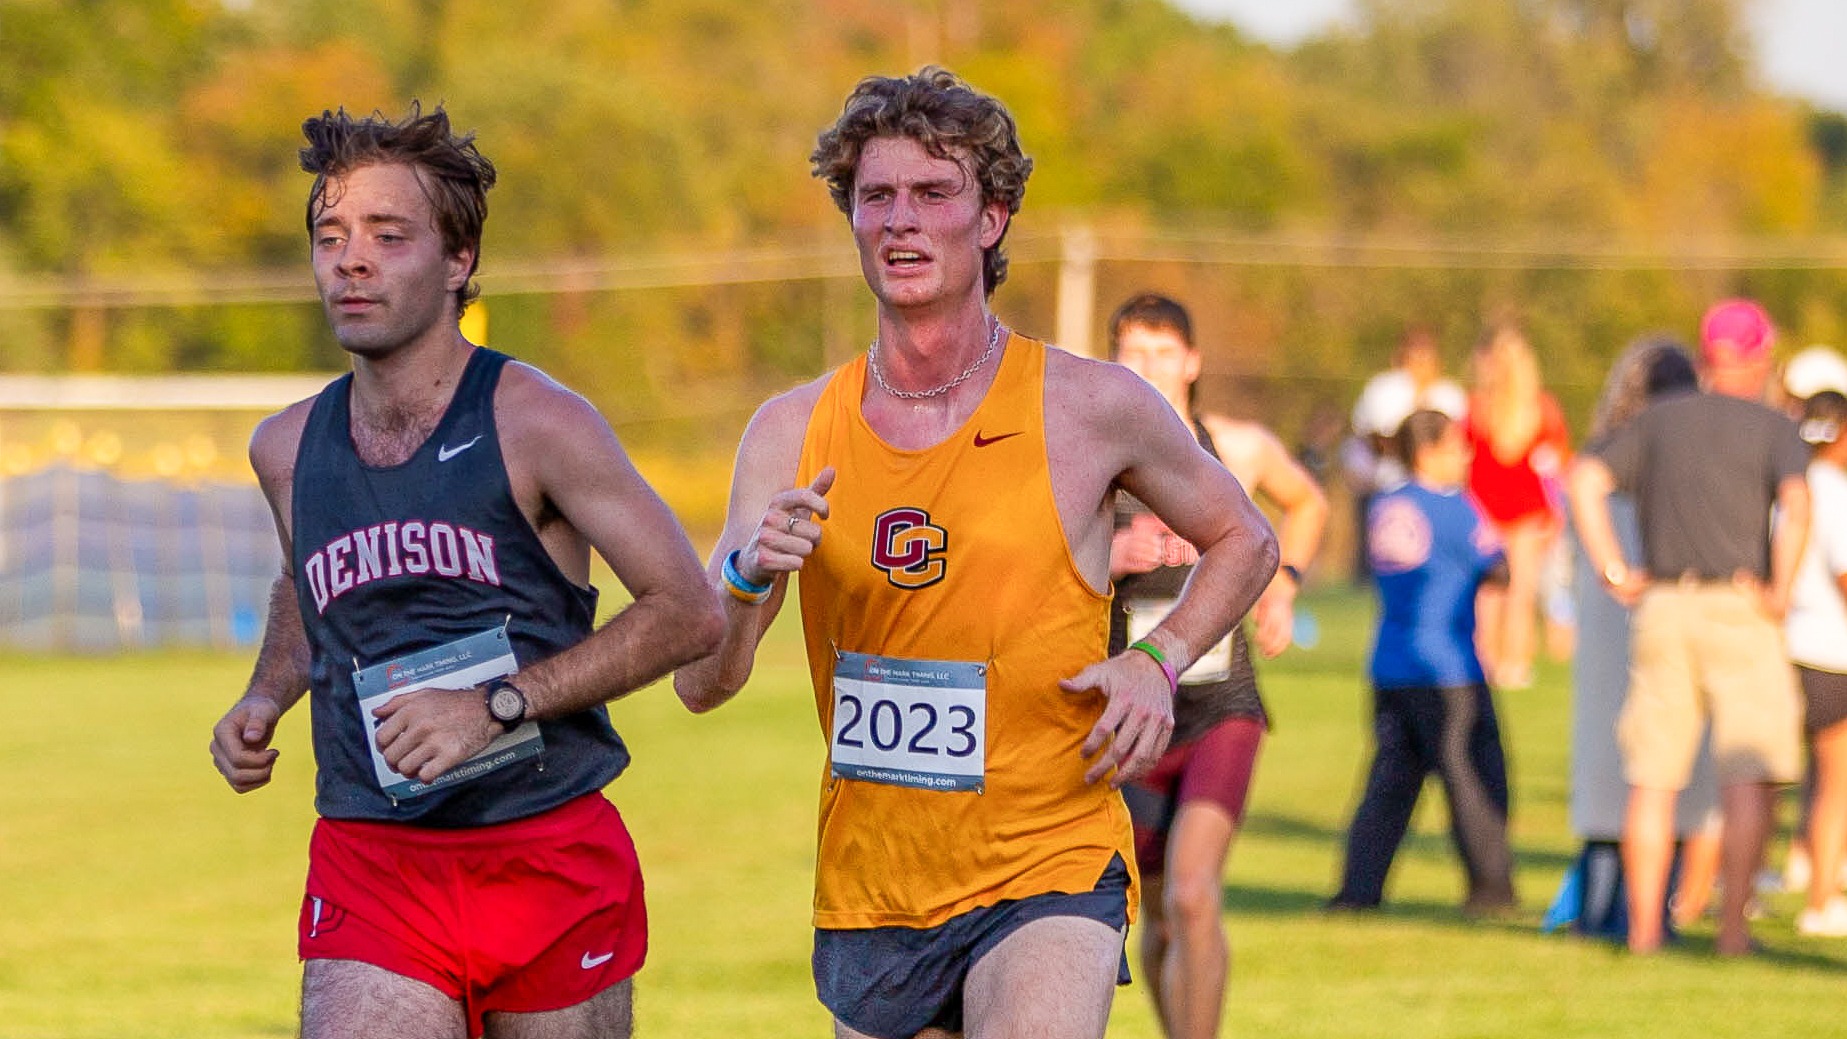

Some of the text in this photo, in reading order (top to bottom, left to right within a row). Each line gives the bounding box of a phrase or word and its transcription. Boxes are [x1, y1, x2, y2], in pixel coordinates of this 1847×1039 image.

[305, 519, 502, 615] DENISON
[936, 671, 950, 680] LLC
[837, 694, 977, 757] 2023
[409, 751, 516, 792] onmarktiming.com
[857, 769, 957, 787] onthemarktiming.com
